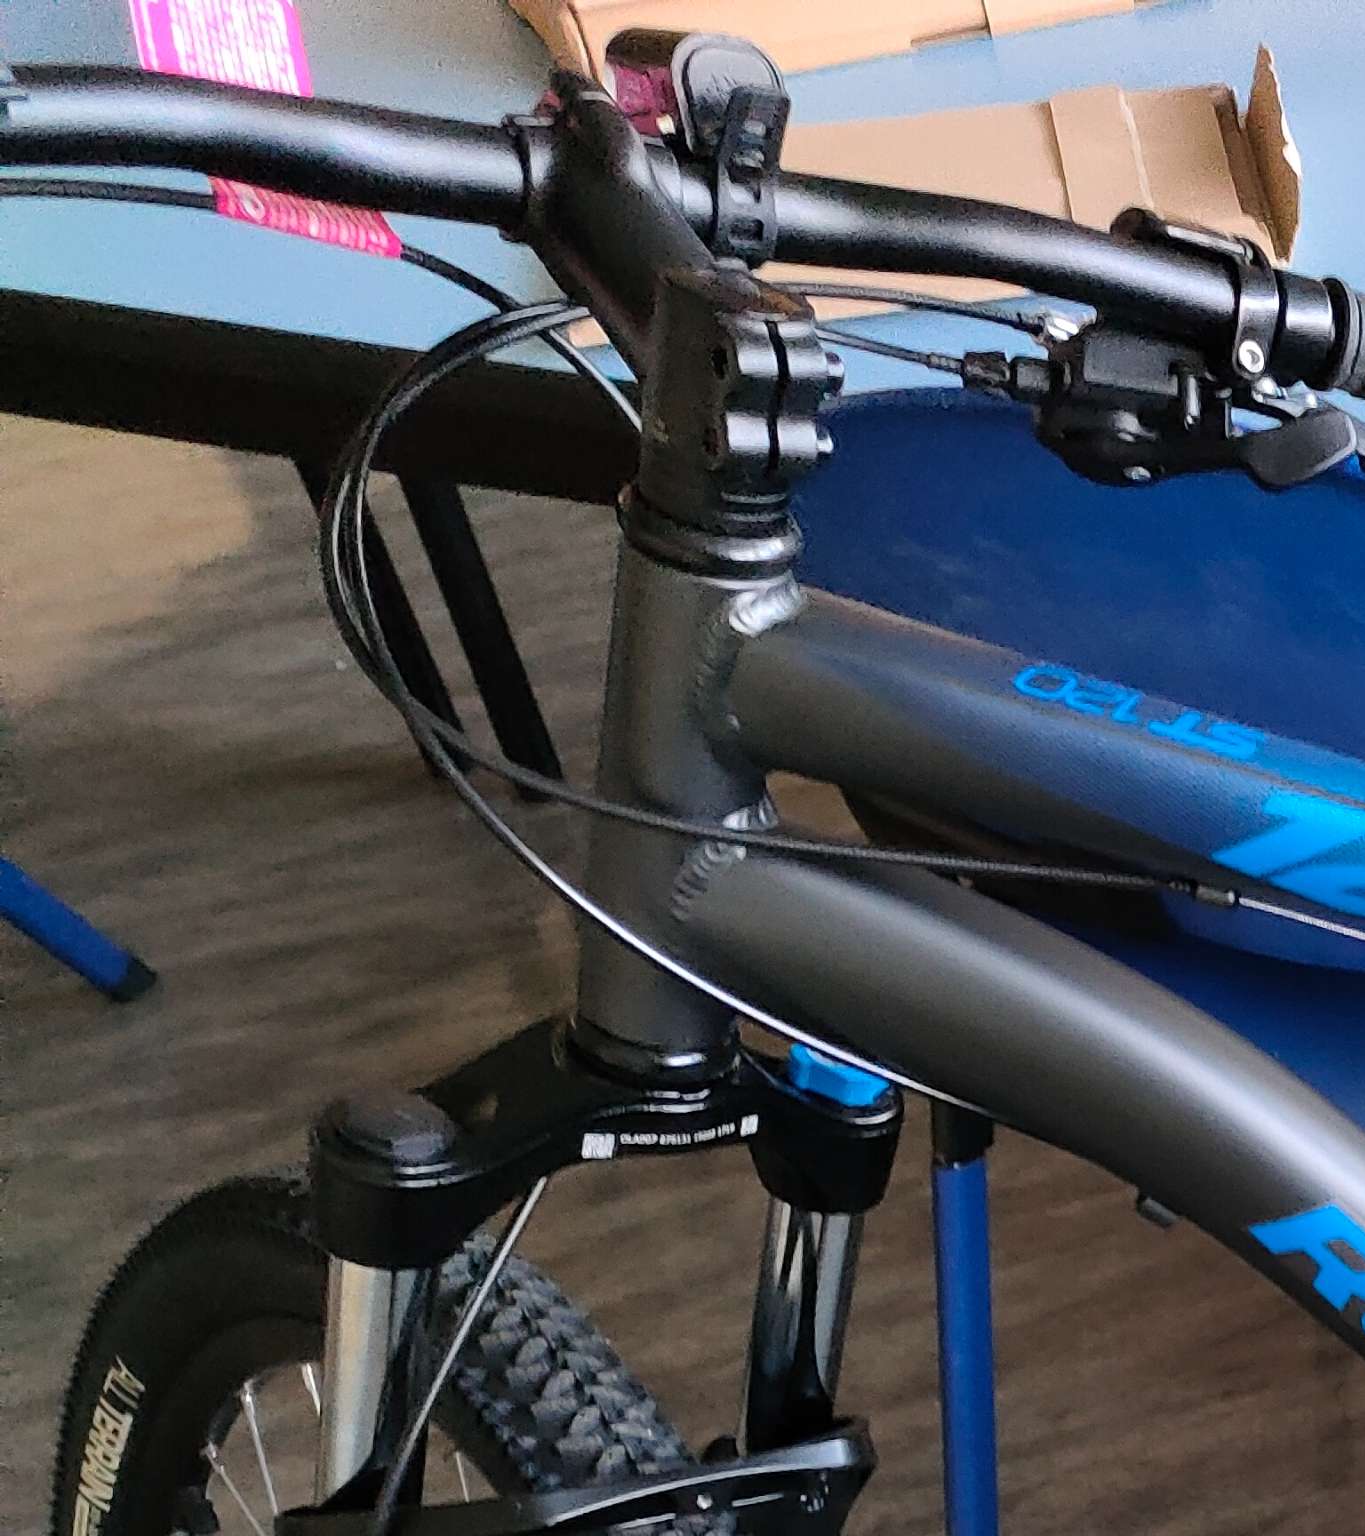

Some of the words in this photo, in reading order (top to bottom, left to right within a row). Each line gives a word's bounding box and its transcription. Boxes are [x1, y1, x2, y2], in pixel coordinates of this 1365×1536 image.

[1013, 661, 1141, 724] 120
[1147, 709, 1264, 761] ST
[102, 1355, 146, 1411] ALL
[77, 1396, 134, 1514] TERRAIN
